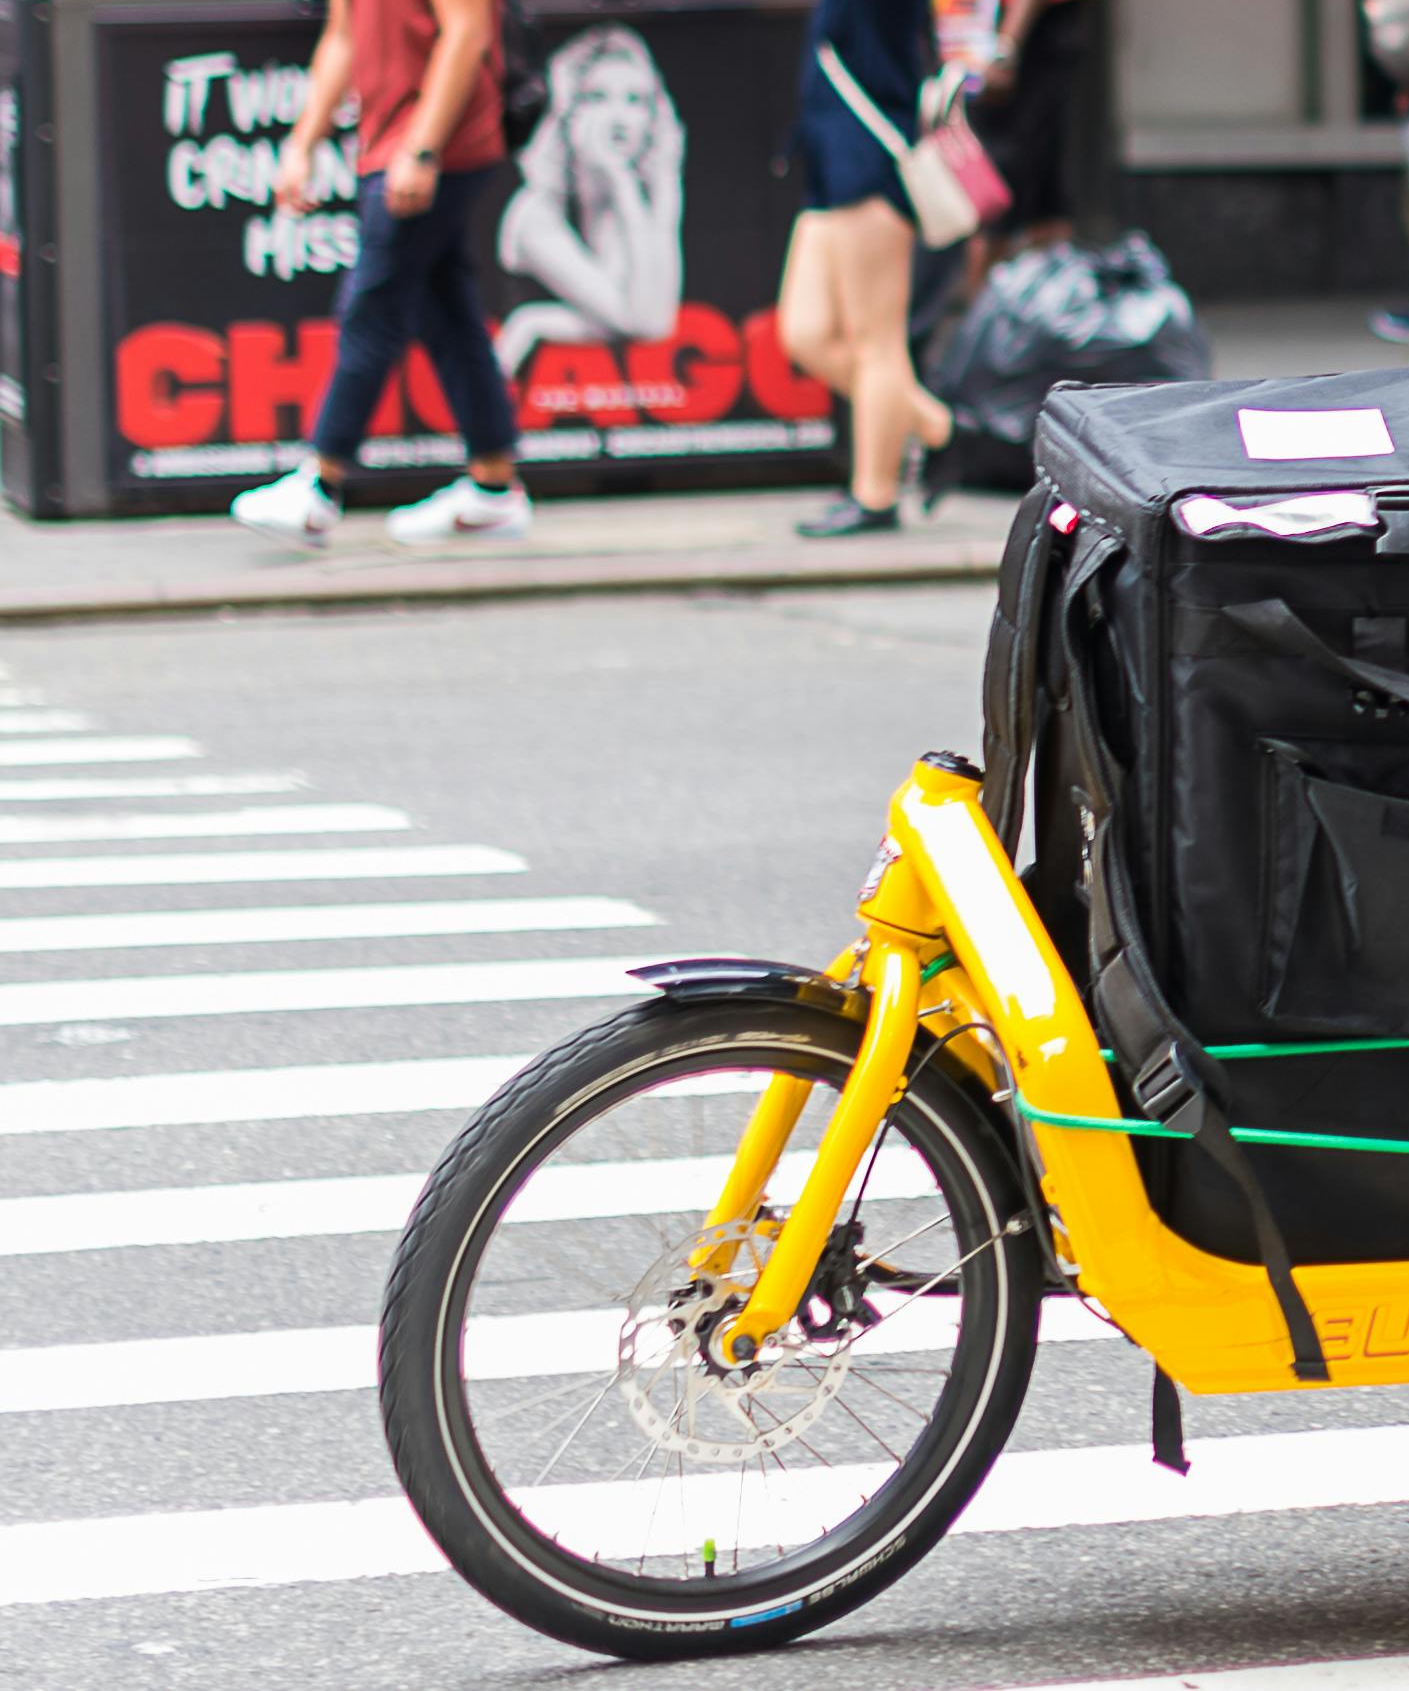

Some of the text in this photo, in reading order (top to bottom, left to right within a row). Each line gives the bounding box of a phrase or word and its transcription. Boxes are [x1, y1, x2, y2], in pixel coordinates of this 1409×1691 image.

[162, 51, 238, 136] IT
[807, 1534, 907, 1607] SCHWALBE
[606, 1613, 727, 1634] MARATHON
